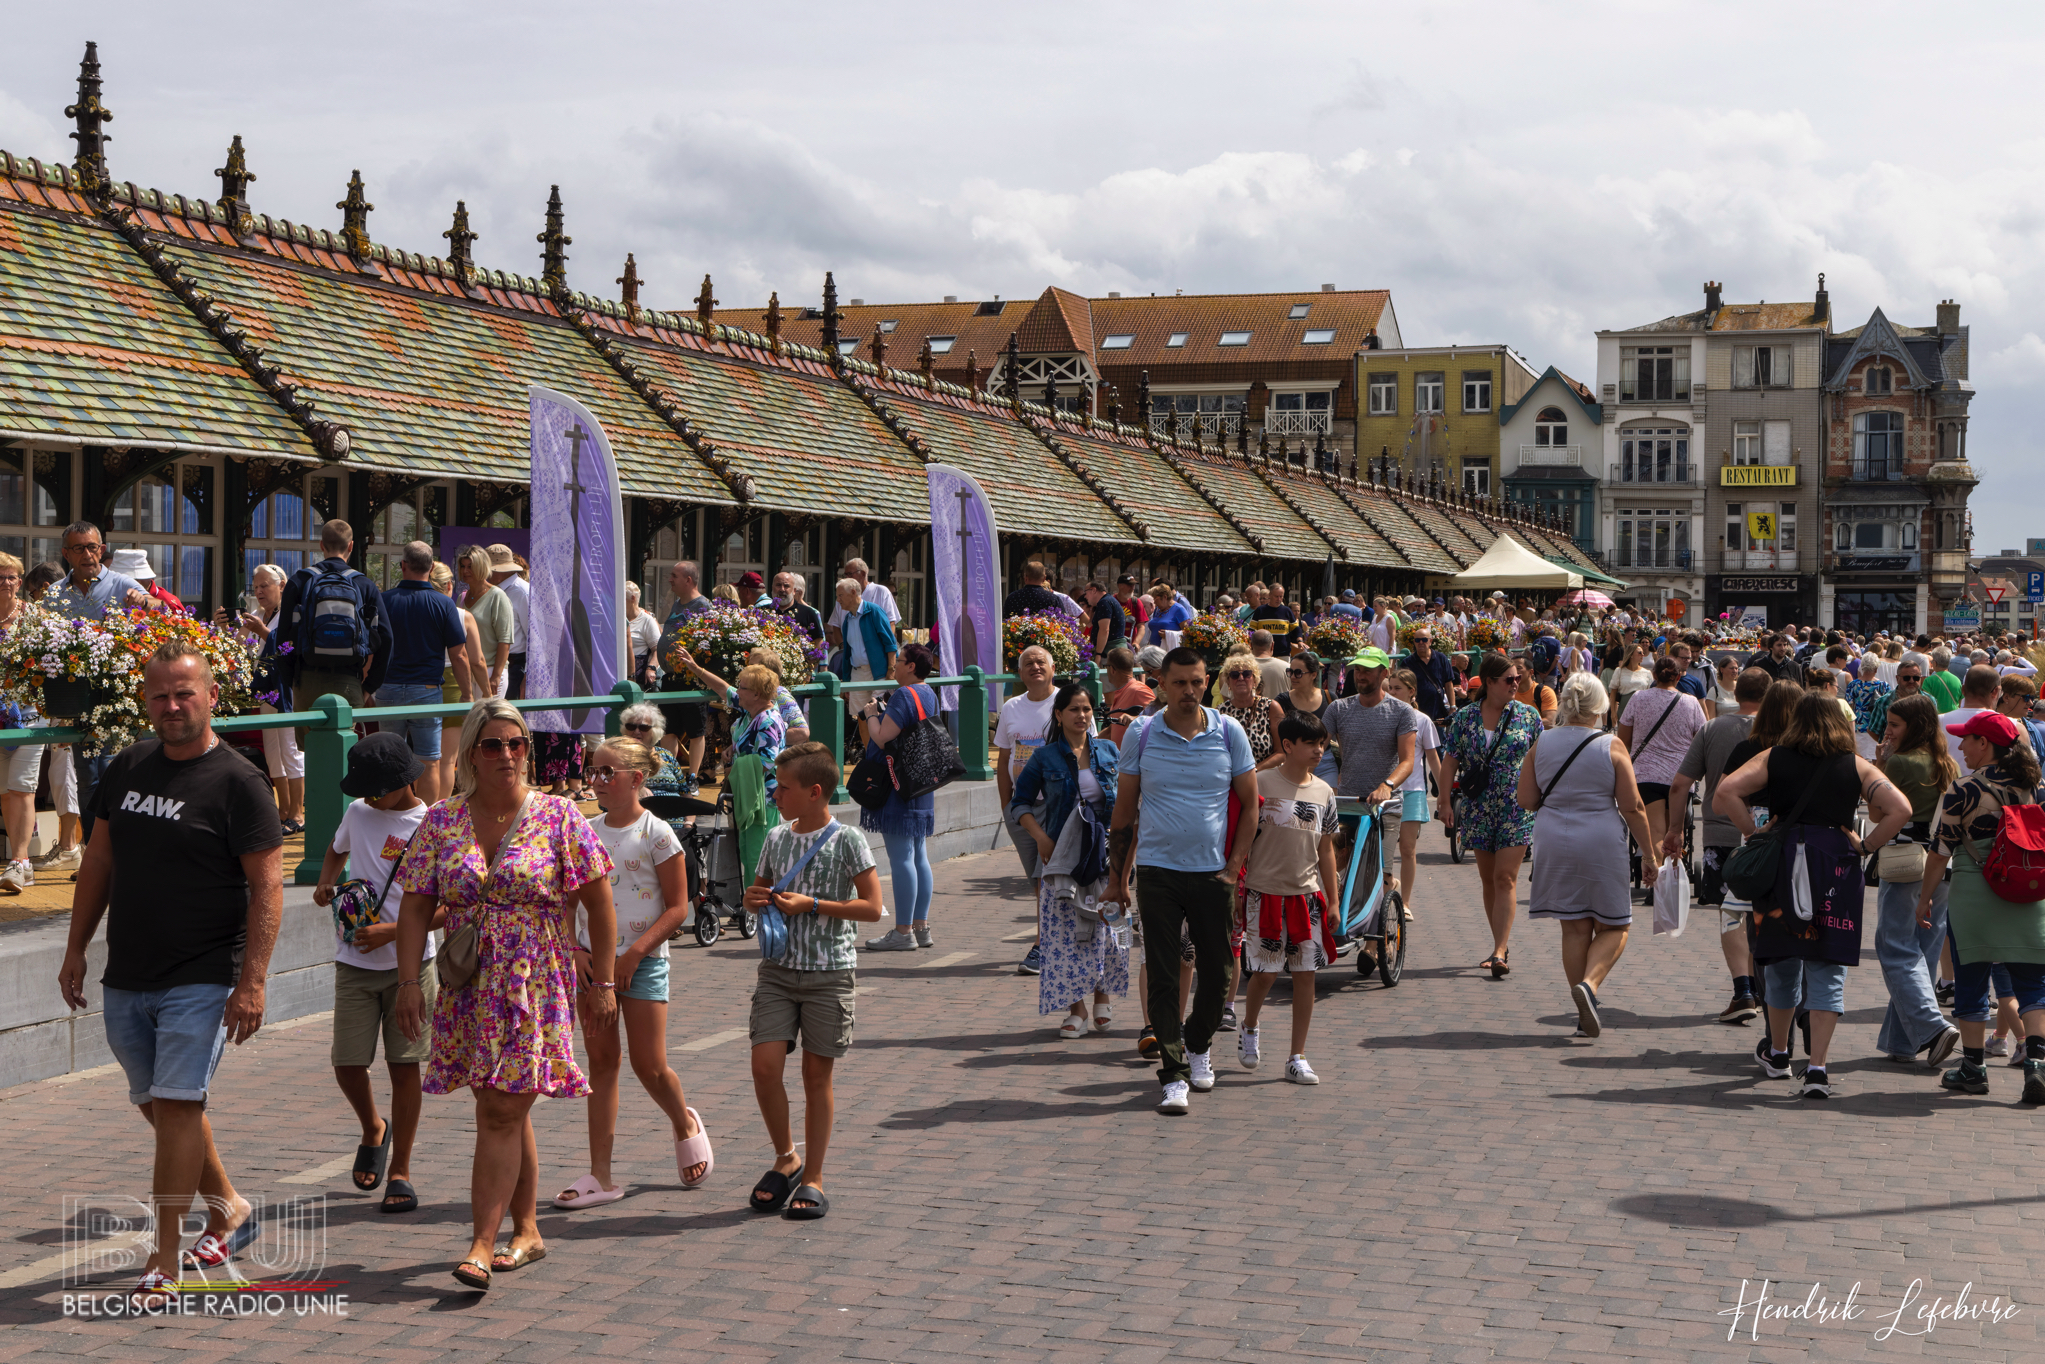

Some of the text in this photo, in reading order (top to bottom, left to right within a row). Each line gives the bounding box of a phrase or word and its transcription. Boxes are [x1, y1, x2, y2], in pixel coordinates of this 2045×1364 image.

[1726, 468, 1791, 484] RESTAURANT
[2031, 573, 2041, 586] P
[120, 790, 186, 821] RAW.
[1815, 914, 1855, 932] TWEILER
